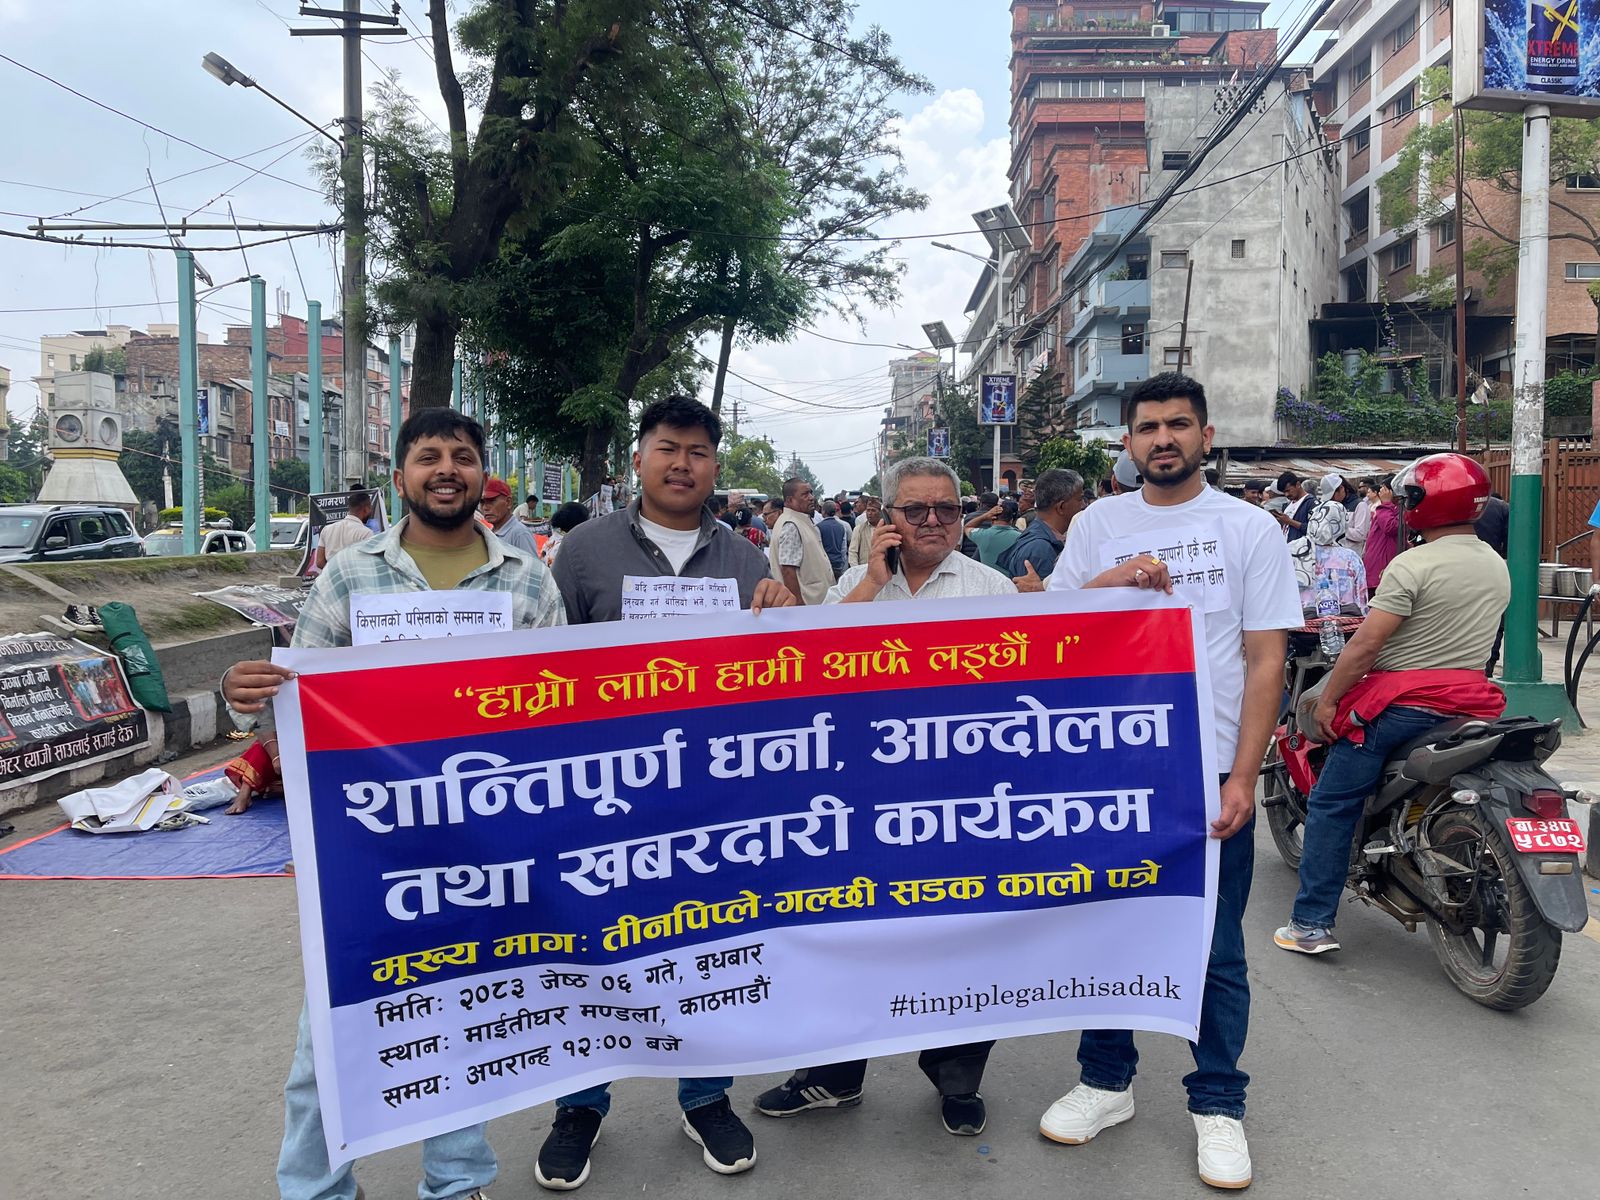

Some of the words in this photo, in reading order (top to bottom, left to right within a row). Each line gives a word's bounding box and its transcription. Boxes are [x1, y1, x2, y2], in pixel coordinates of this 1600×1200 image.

[1157, 541, 1184, 563] व्यापारी
[1187, 537, 1199, 563] एकै
[1202, 540, 1218, 558] स्वर
[356, 609, 401, 630] किसानको
[405, 606, 449, 627] पसिनाको
[453, 610, 485, 626] सम्मान
[595, 657, 700, 703] लागि
[714, 646, 806, 692] हामी
[822, 638, 913, 680] आफै
[926, 630, 1032, 680] लड्छौं
[53, 687, 62, 699] र
[92, 727, 116, 751] सजाई
[343, 728, 687, 834] शान्तिपूर्ण
[708, 711, 845, 778] धर्ना,
[871, 695, 1174, 764] आन्दोलन
[381, 858, 536, 921] तथा
[557, 794, 855, 897] खबरदारी
[874, 781, 1155, 846] कार्यक्रम
[1515, 821, 1573, 833] बा.३४प
[1515, 834, 1584, 849] ५८७२
[371, 941, 480, 986] मूख्य
[889, 874, 987, 906] सडक
[997, 862, 1096, 898] कालो
[1106, 858, 1163, 890] पत्रे
[460, 976, 525, 1011] २०८३
[539, 969, 589, 990] जेष्ठ
[601, 973, 633, 994] ०६
[644, 958, 684, 985] गते,
[695, 943, 764, 980] बुधबार
[889, 975, 1182, 1018] #tinpiplegalchisadak
[464, 1005, 570, 1043] माईतीघर
[579, 1003, 666, 1028] मण्डला,
[678, 974, 772, 1015] काठमाडौं
[466, 1045, 552, 1086] अपरान्ह
[561, 1033, 633, 1058] १२:००
[644, 1033, 684, 1052] बजे
